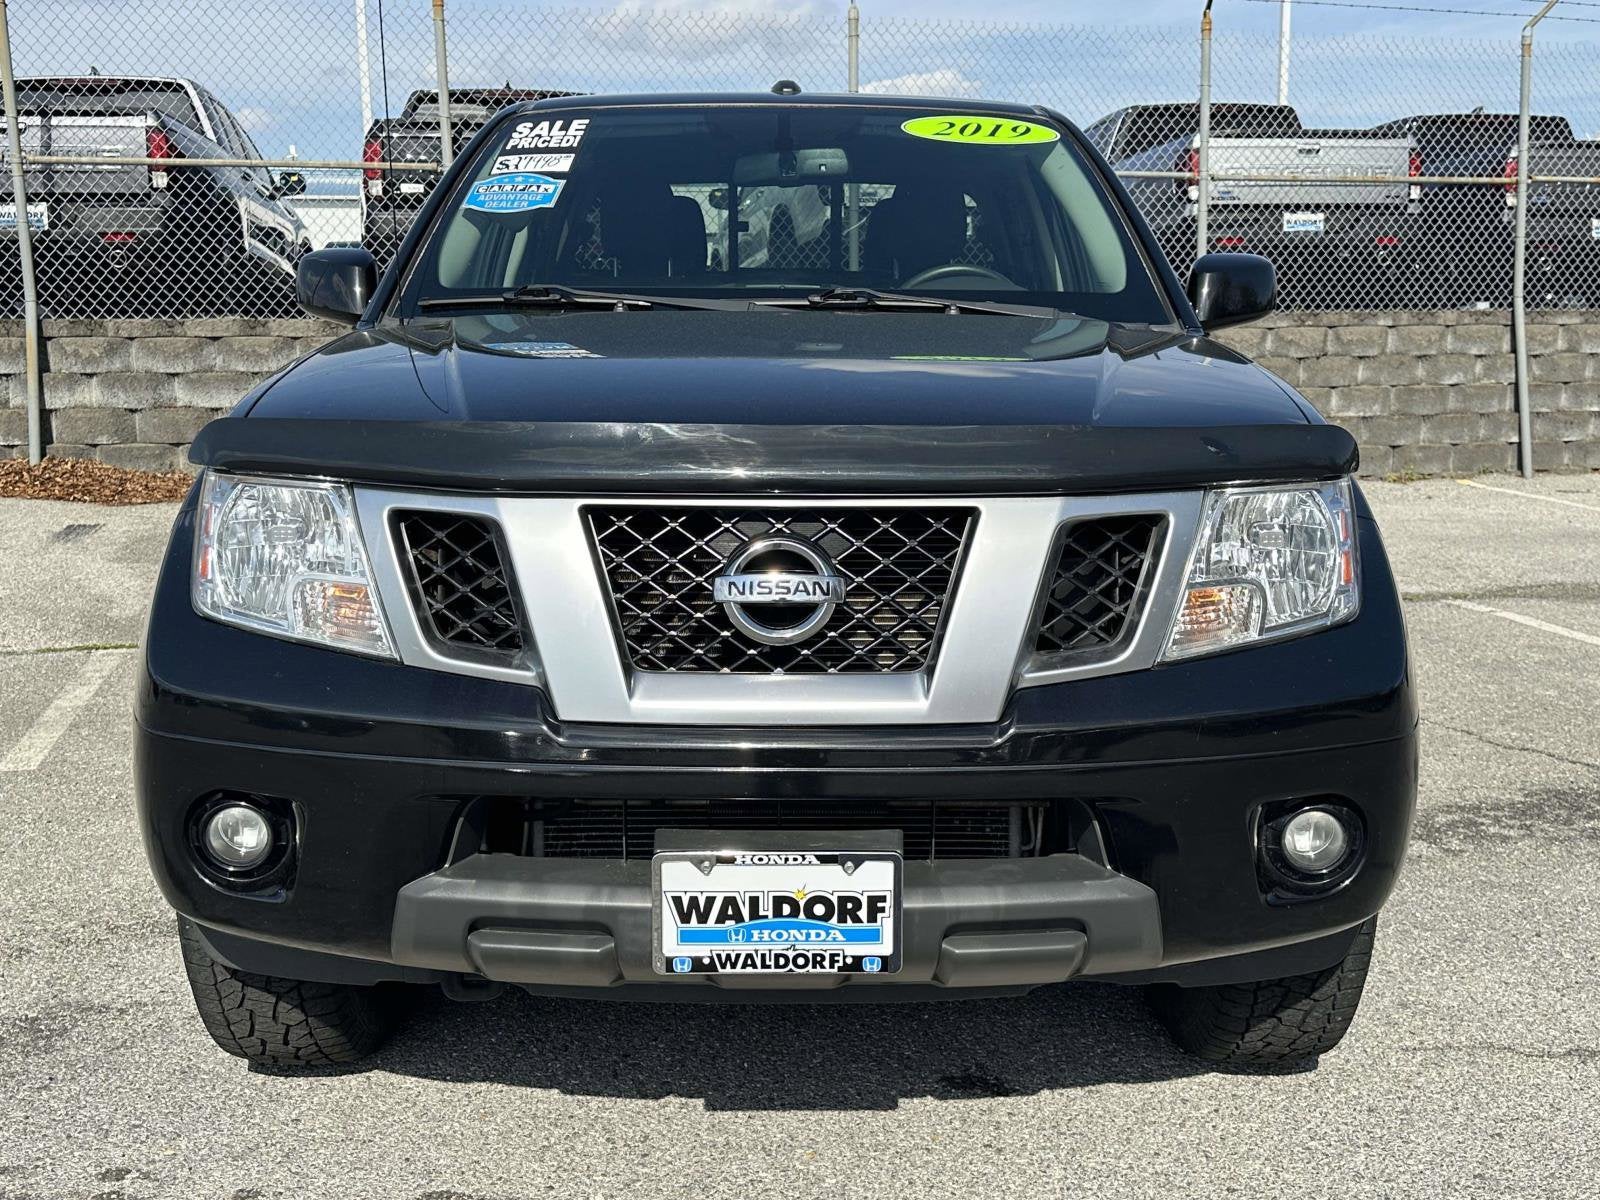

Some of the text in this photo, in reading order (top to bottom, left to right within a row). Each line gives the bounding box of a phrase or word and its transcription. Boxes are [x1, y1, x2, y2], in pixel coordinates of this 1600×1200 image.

[511, 119, 590, 139] SALE
[932, 121, 1032, 139] 2019
[505, 135, 582, 150] PRICED!
[476, 184, 552, 193] CARFAX
[477, 193, 544, 202] ADVANTAGE
[484, 201, 529, 209] DEALER
[727, 580, 832, 597] NISSAN
[734, 854, 821, 865] HONDA
[670, 894, 888, 925] WALDORF
[751, 929, 847, 942] HONDA
[714, 952, 843, 970] WALDORF
